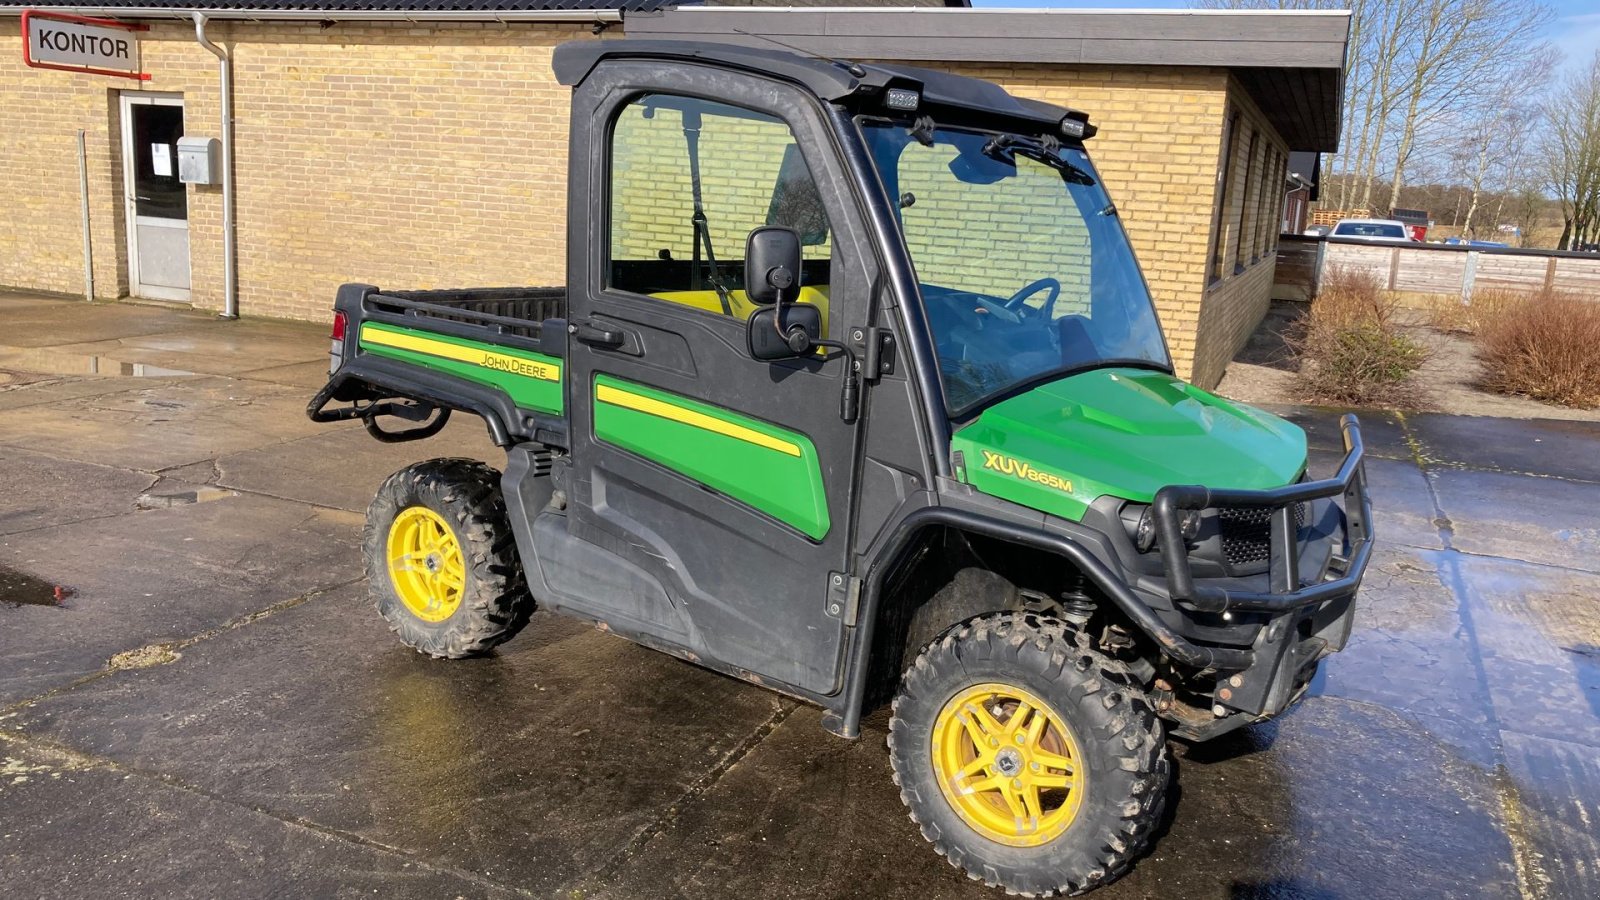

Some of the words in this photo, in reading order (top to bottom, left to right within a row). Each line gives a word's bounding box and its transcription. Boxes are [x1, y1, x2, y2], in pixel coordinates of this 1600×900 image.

[39, 29, 129, 59] KONTOR
[481, 354, 510, 370] JOHN
[511, 359, 547, 378] DEERE
